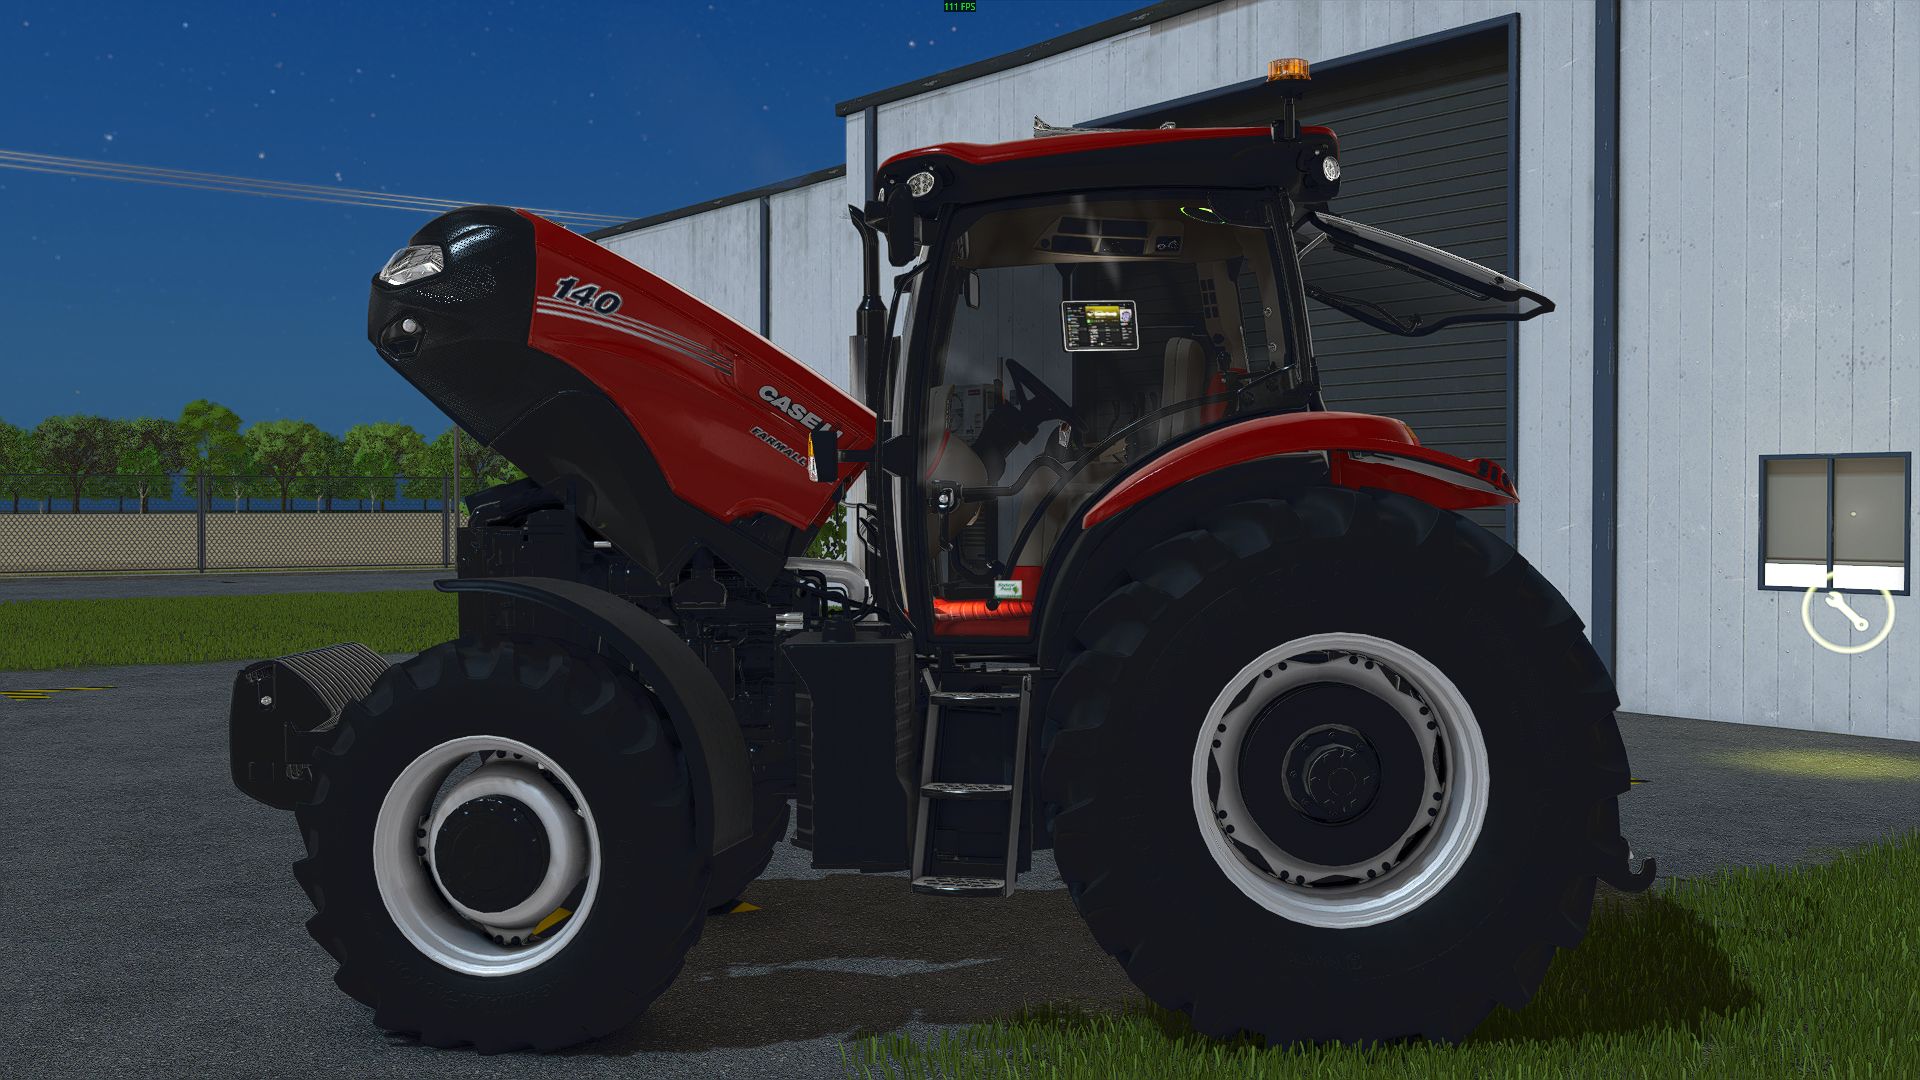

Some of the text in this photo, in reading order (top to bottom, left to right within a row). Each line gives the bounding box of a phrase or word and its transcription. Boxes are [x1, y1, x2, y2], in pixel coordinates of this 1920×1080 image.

[552, 275, 623, 315] 140
[758, 385, 823, 430] CASE
[749, 426, 808, 467] FARMALL
